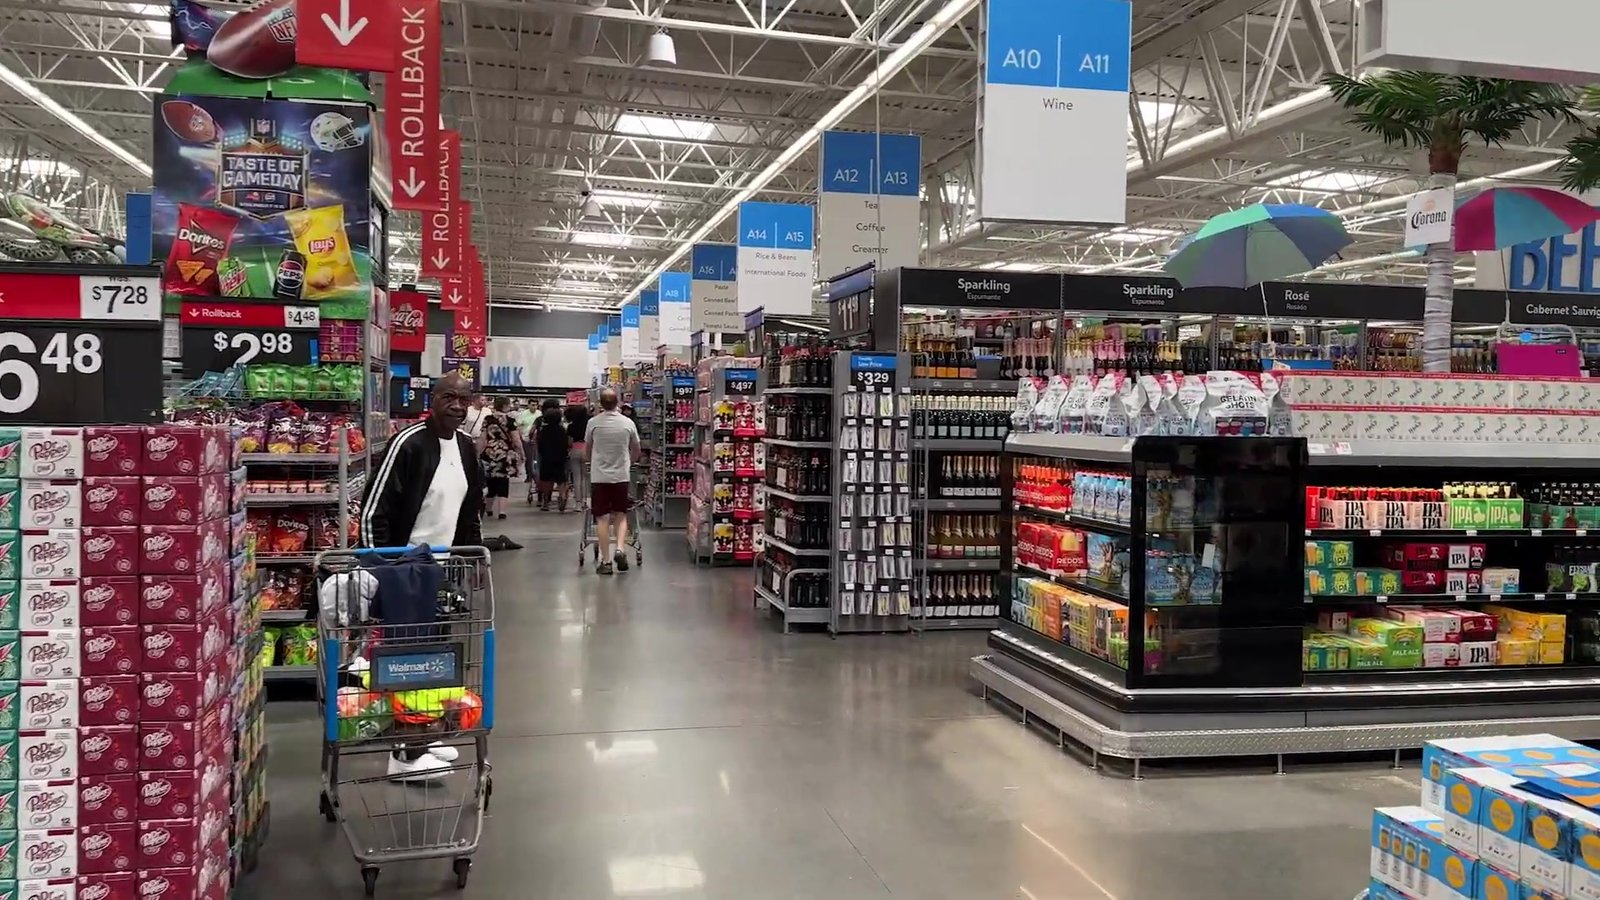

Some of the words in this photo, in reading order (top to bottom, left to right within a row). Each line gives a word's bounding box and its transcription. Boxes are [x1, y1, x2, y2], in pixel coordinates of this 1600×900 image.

[1002, 48, 1041, 69] A10
[1079, 53, 1109, 74] A11
[401, 7, 425, 156] ROLLBACK
[1042, 98, 1074, 111] Wine
[227, 157, 276, 172] TASTE
[280, 158, 301, 173] OF
[223, 171, 302, 190] GAMEDAY
[833, 169, 859, 183] A12
[883, 172, 909, 185] A13
[864, 200, 878, 209] Tea
[856, 222, 886, 232] Coffee
[1411, 209, 1447, 230] Corona
[180, 227, 226, 251] Doritos
[747, 229, 767, 240] A14
[784, 231, 804, 243] A15
[755, 252, 770, 260] Rice
[698, 266, 715, 275] A16
[744, 269, 786, 277] International
[665, 289, 679, 297] A18
[957, 278, 1011, 300] Sparkling
[1122, 284, 1174, 304] Sparkling
[1284, 289, 1310, 301] Rosé
[966, 292, 1000, 302] Espumante
[1131, 298, 1165, 308] Espumante
[202, 308, 242, 318] Rollback
[1285, 302, 1308, 311] Rosado
[1525, 303, 1570, 315] Cabernet
[489, 366, 524, 387] MILK
[29, 443, 68, 460] Pepper
[29, 493, 68, 510] Pepper
[1345, 502, 1365, 516] IPA
[1385, 502, 1406, 516] IPA
[1320, 507, 1334, 523] IPA
[1422, 502, 1443, 517] IPA
[1455, 505, 1473, 524] IPA
[1491, 505, 1509, 524] IPA
[277, 519, 309, 531] Doritos
[1345, 517, 1364, 529] IPA
[1385, 517, 1405, 529] IPA
[1422, 517, 1442, 529] IPA
[28, 544, 67, 561] Pepper
[1451, 553, 1467, 565] IPA
[1449, 580, 1464, 592] IPA
[28, 594, 67, 611] Pepper
[28, 645, 67, 662] Pepper
[1470, 647, 1490, 663] IPA
[388, 661, 430, 674] Walmart
[26, 695, 65, 712] Pepper
[25, 745, 64, 762] Pepper
[26, 794, 65, 811] Pepper
[25, 844, 64, 861] Pepper
